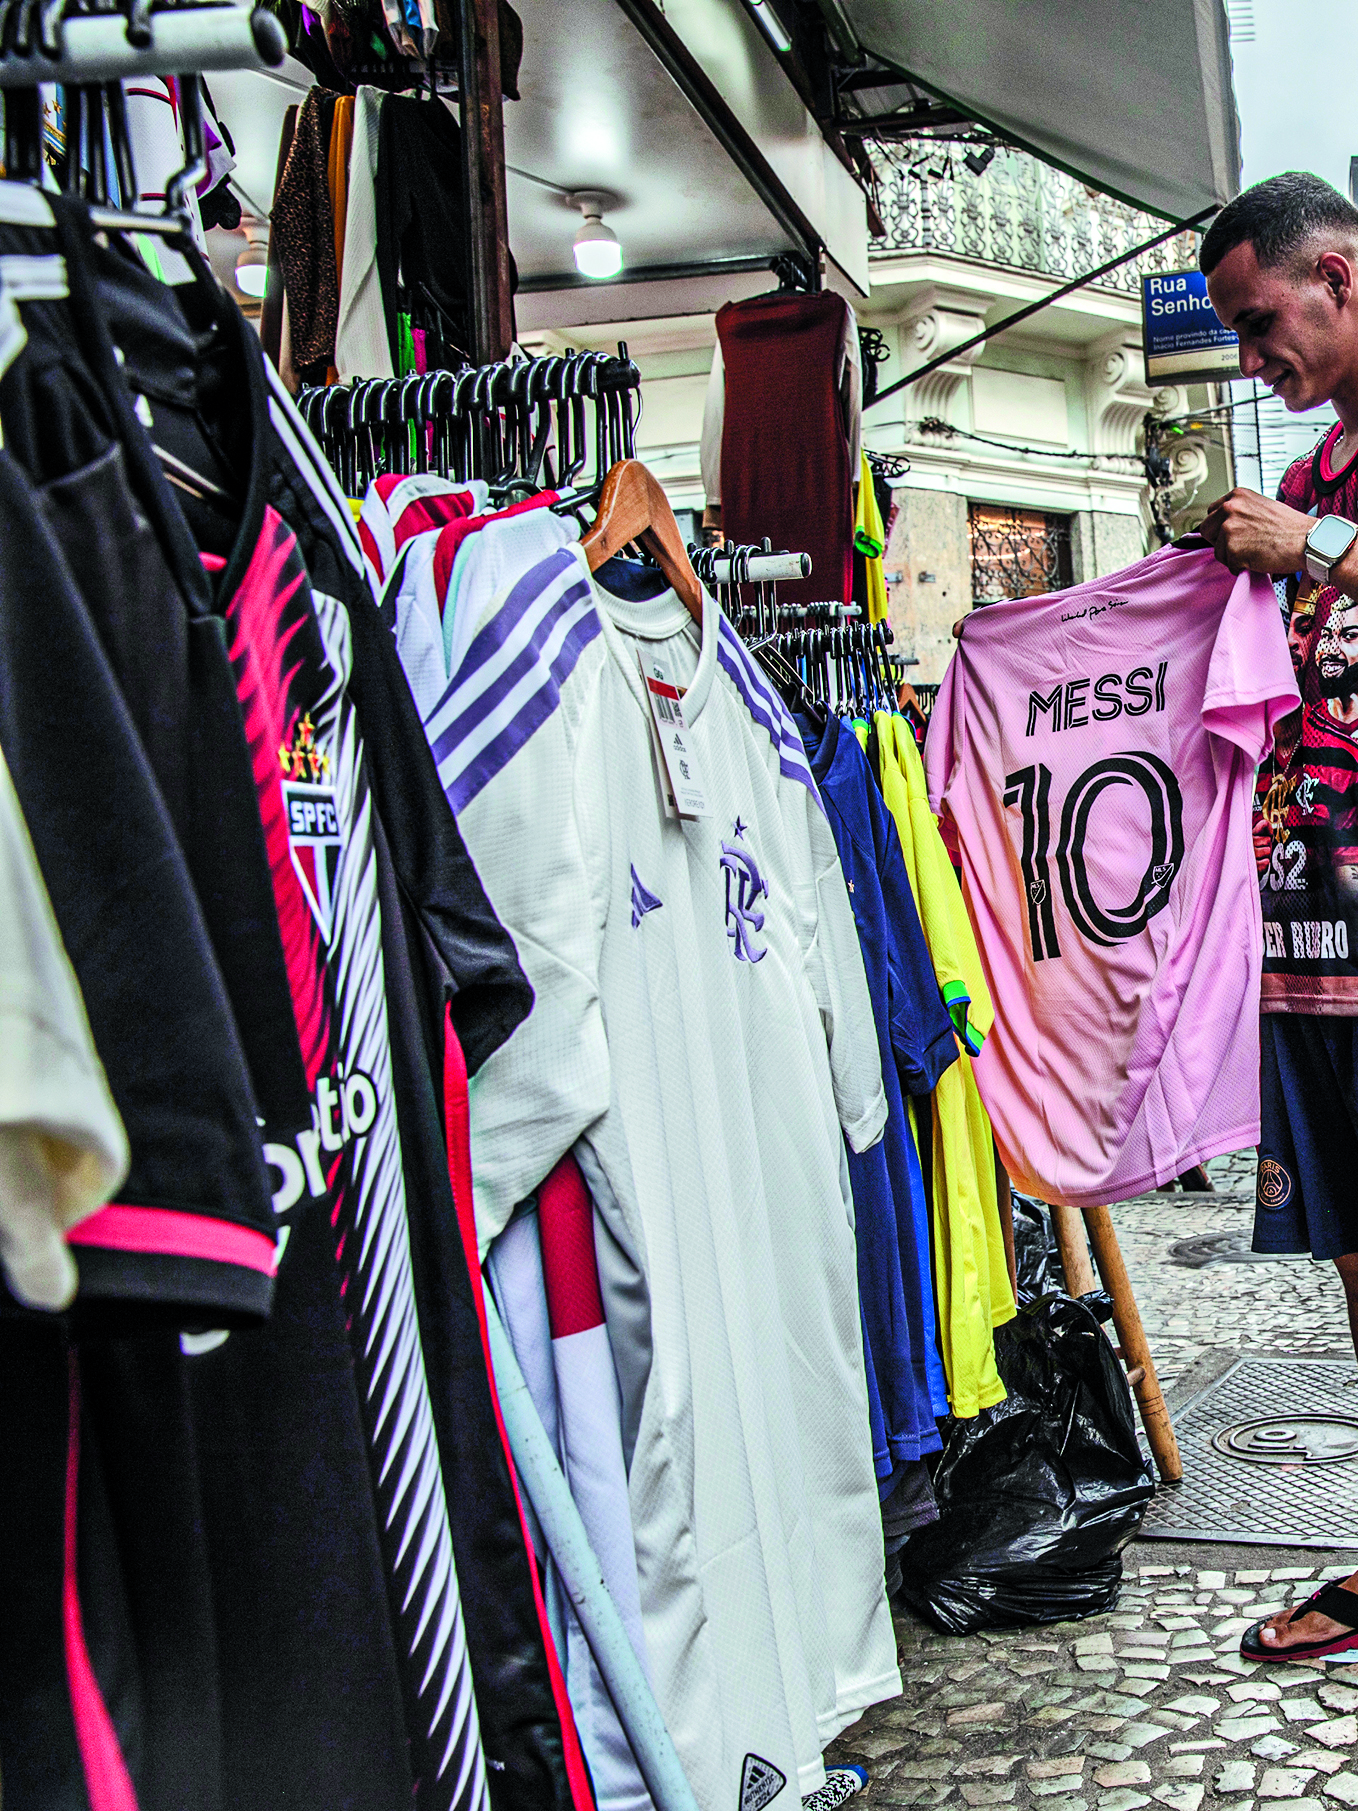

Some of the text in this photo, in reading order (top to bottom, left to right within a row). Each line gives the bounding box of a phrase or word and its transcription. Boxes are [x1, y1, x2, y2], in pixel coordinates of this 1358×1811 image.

[1150, 277, 1187, 295] Rua
[1153, 334, 1174, 343] Nome
[1175, 330, 1207, 341] provindo
[1175, 339, 1212, 347] Fernandes
[1025, 661, 1168, 737] MESSI
[290, 800, 338, 836] SPFC
[1003, 751, 1185, 962] 10
[1262, 921, 1287, 958] ER
